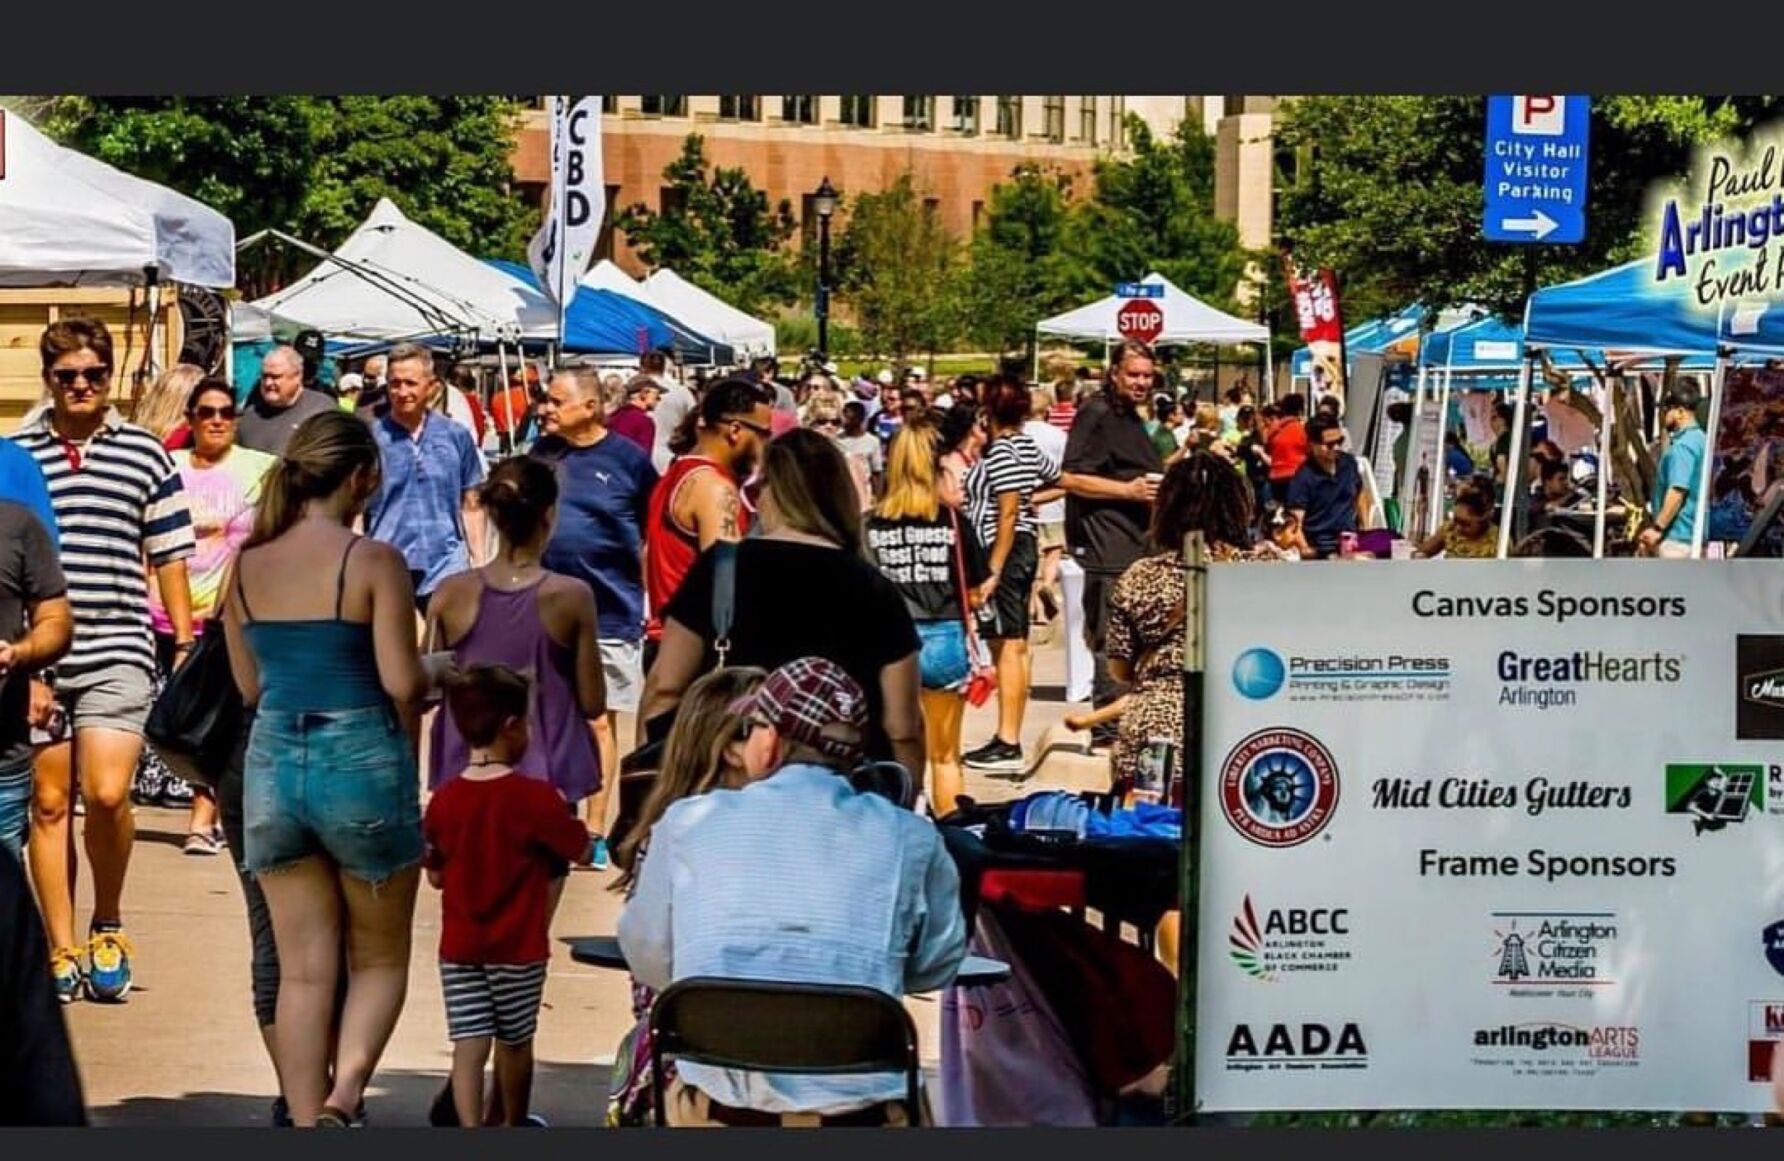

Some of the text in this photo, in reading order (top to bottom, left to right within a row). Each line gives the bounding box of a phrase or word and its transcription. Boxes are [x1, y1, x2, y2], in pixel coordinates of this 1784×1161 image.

[1523, 95, 1555, 124] P
[1494, 140, 1581, 160] City Hall
[566, 109, 591, 227] CBD
[1503, 161, 1570, 179] Visitor
[1498, 182, 1573, 203] Parking
[1120, 312, 1161, 331] STOP
[1412, 589, 1686, 623] Canvas Sponsors
[1290, 655, 1450, 672] Precision Press
[1497, 650, 1681, 683] GreatHearts
[1290, 680, 1338, 691] Printing
[1354, 680, 1400, 691] Graphic
[1406, 679, 1450, 691] Design
[1499, 686, 1576, 709] Arlington
[1371, 776, 1632, 816] Mid Cities Gutters
[1419, 849, 1676, 881] Frame Sponsors
[1265, 909, 1349, 934] ABCC
[1538, 920, 1618, 944] Arlington
[1264, 951, 1351, 960] BLACK CHAMBER
[1538, 940, 1597, 959] Citizen
[1281, 963, 1338, 971] COMMERCE
[1538, 960, 1596, 978] Media
[1226, 1023, 1367, 1056] AADA
[1588, 1047, 1638, 1058] LEAGUE
